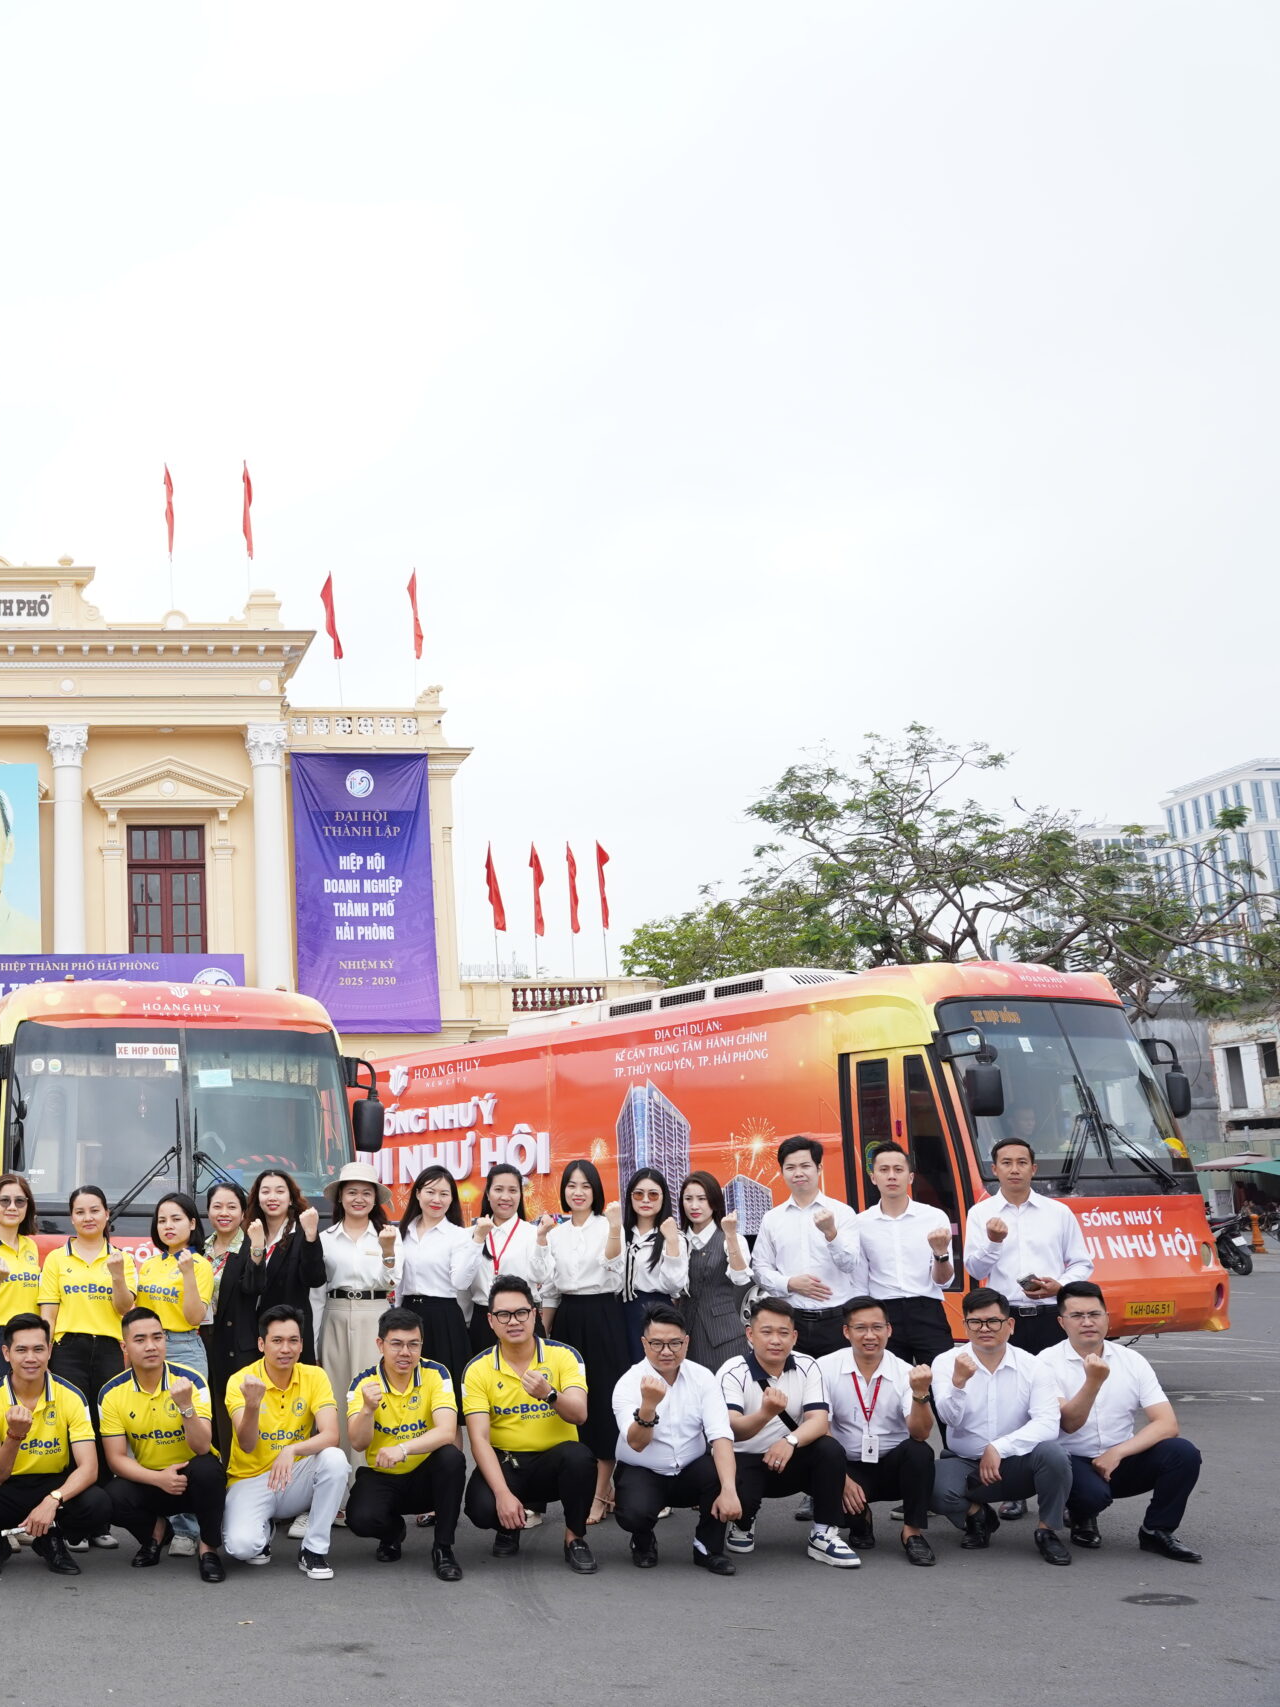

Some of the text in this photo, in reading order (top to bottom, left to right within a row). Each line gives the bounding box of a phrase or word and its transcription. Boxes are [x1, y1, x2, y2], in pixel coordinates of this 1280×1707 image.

[16, 594, 52, 617] PHỐ
[335, 810, 388, 824] ĐẠI HỘI
[322, 824, 401, 838] THÀNH LẬP
[339, 852, 385, 873] HIỆP HỘI
[324, 875, 402, 896] DOANH NGHIỆP
[333, 898, 396, 917] THÀNH PHỐ
[336, 922, 395, 941] HẢI PHÒNG
[29, 960, 68, 971] THÀNH
[71, 959, 96, 971] PHỐ
[97, 960, 117, 971] HẢI
[120, 960, 159, 970] PHÒNG
[338, 959, 395, 971] NHIỆM KỲ
[338, 976, 363, 986] 2025
[372, 976, 396, 986] 2030
[143, 1003, 222, 1012] HOANG HUY
[655, 1029, 670, 1042] ĐỊA
[117, 1046, 129, 1055] XE
[648, 1043, 680, 1058] TRUNG
[682, 1040, 702, 1052] TÂM
[706, 1035, 734, 1049] HÀNH
[736, 1031, 768, 1045] CHÍNH
[713, 1051, 731, 1066] HẢI
[733, 1048, 769, 1062] PHÒNG
[414, 1058, 481, 1081] HOANG HUY
[425, 1079, 444, 1088] NEW
[383, 1092, 498, 1137] ỐNG NHƯ Ý
[480, 1123, 551, 1187] HỘI
[1081, 1206, 1163, 1227] SỐNG NHƯ Ý
[1085, 1227, 1198, 1263] UI NHƯ HỘI
[63, 1283, 113, 1295] RecBoo
[137, 1284, 180, 1298] ecBook
[493, 1403, 554, 1416] RecBoo
[374, 1419, 428, 1436] Recook
[20, 1437, 60, 1450] cBook
